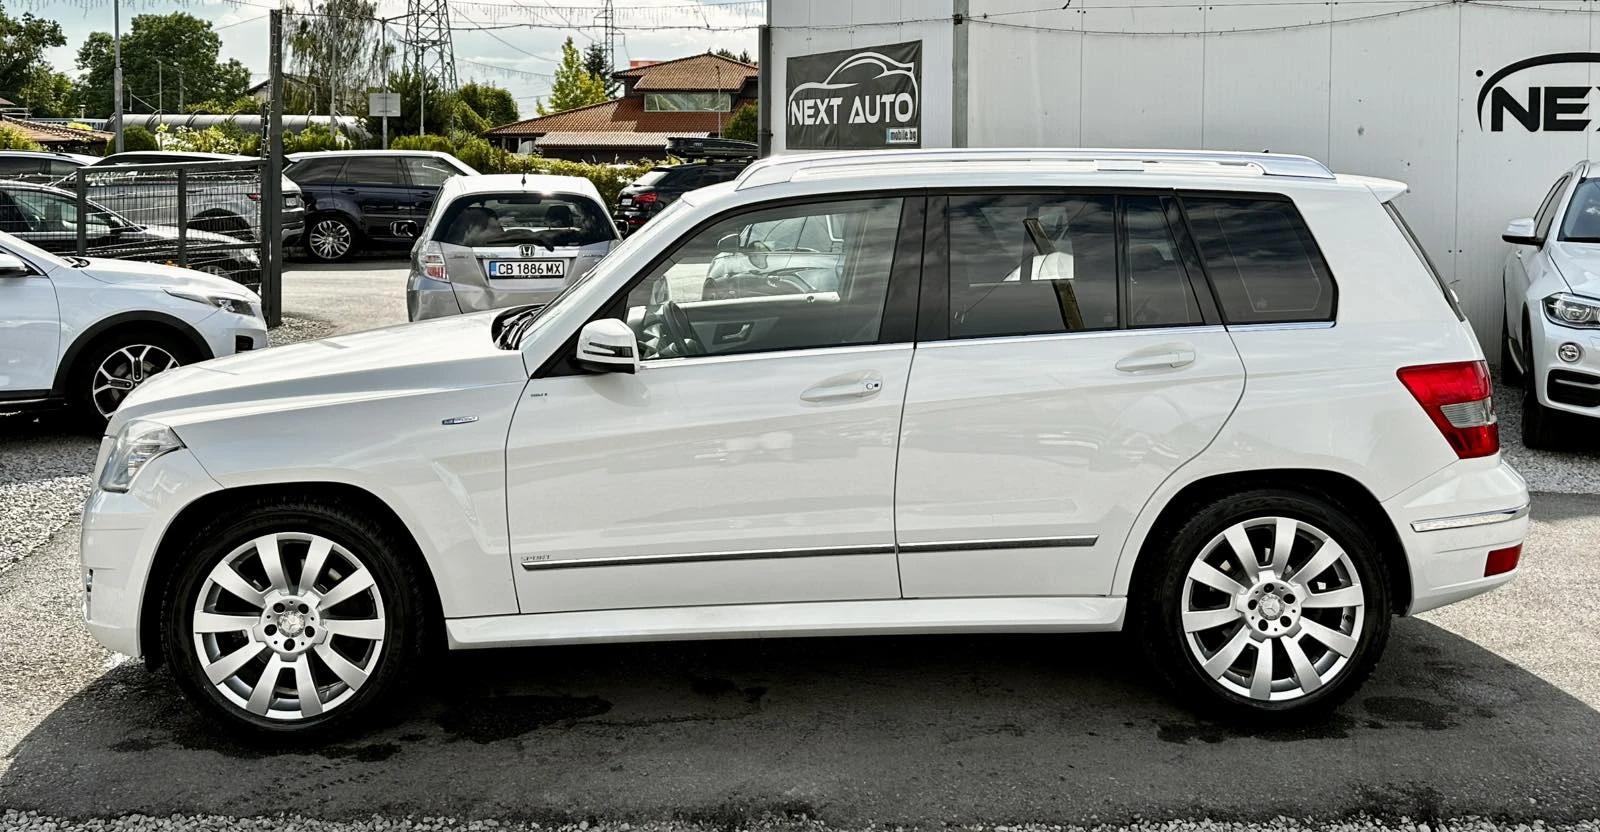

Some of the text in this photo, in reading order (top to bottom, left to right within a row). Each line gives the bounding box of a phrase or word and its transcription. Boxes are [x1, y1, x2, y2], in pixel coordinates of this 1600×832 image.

[791, 92, 913, 125] NEXT AUTO
[1491, 86, 1600, 132] NE
[890, 129, 917, 141] mobile.bg
[498, 263, 562, 275] CB 1886 MX
